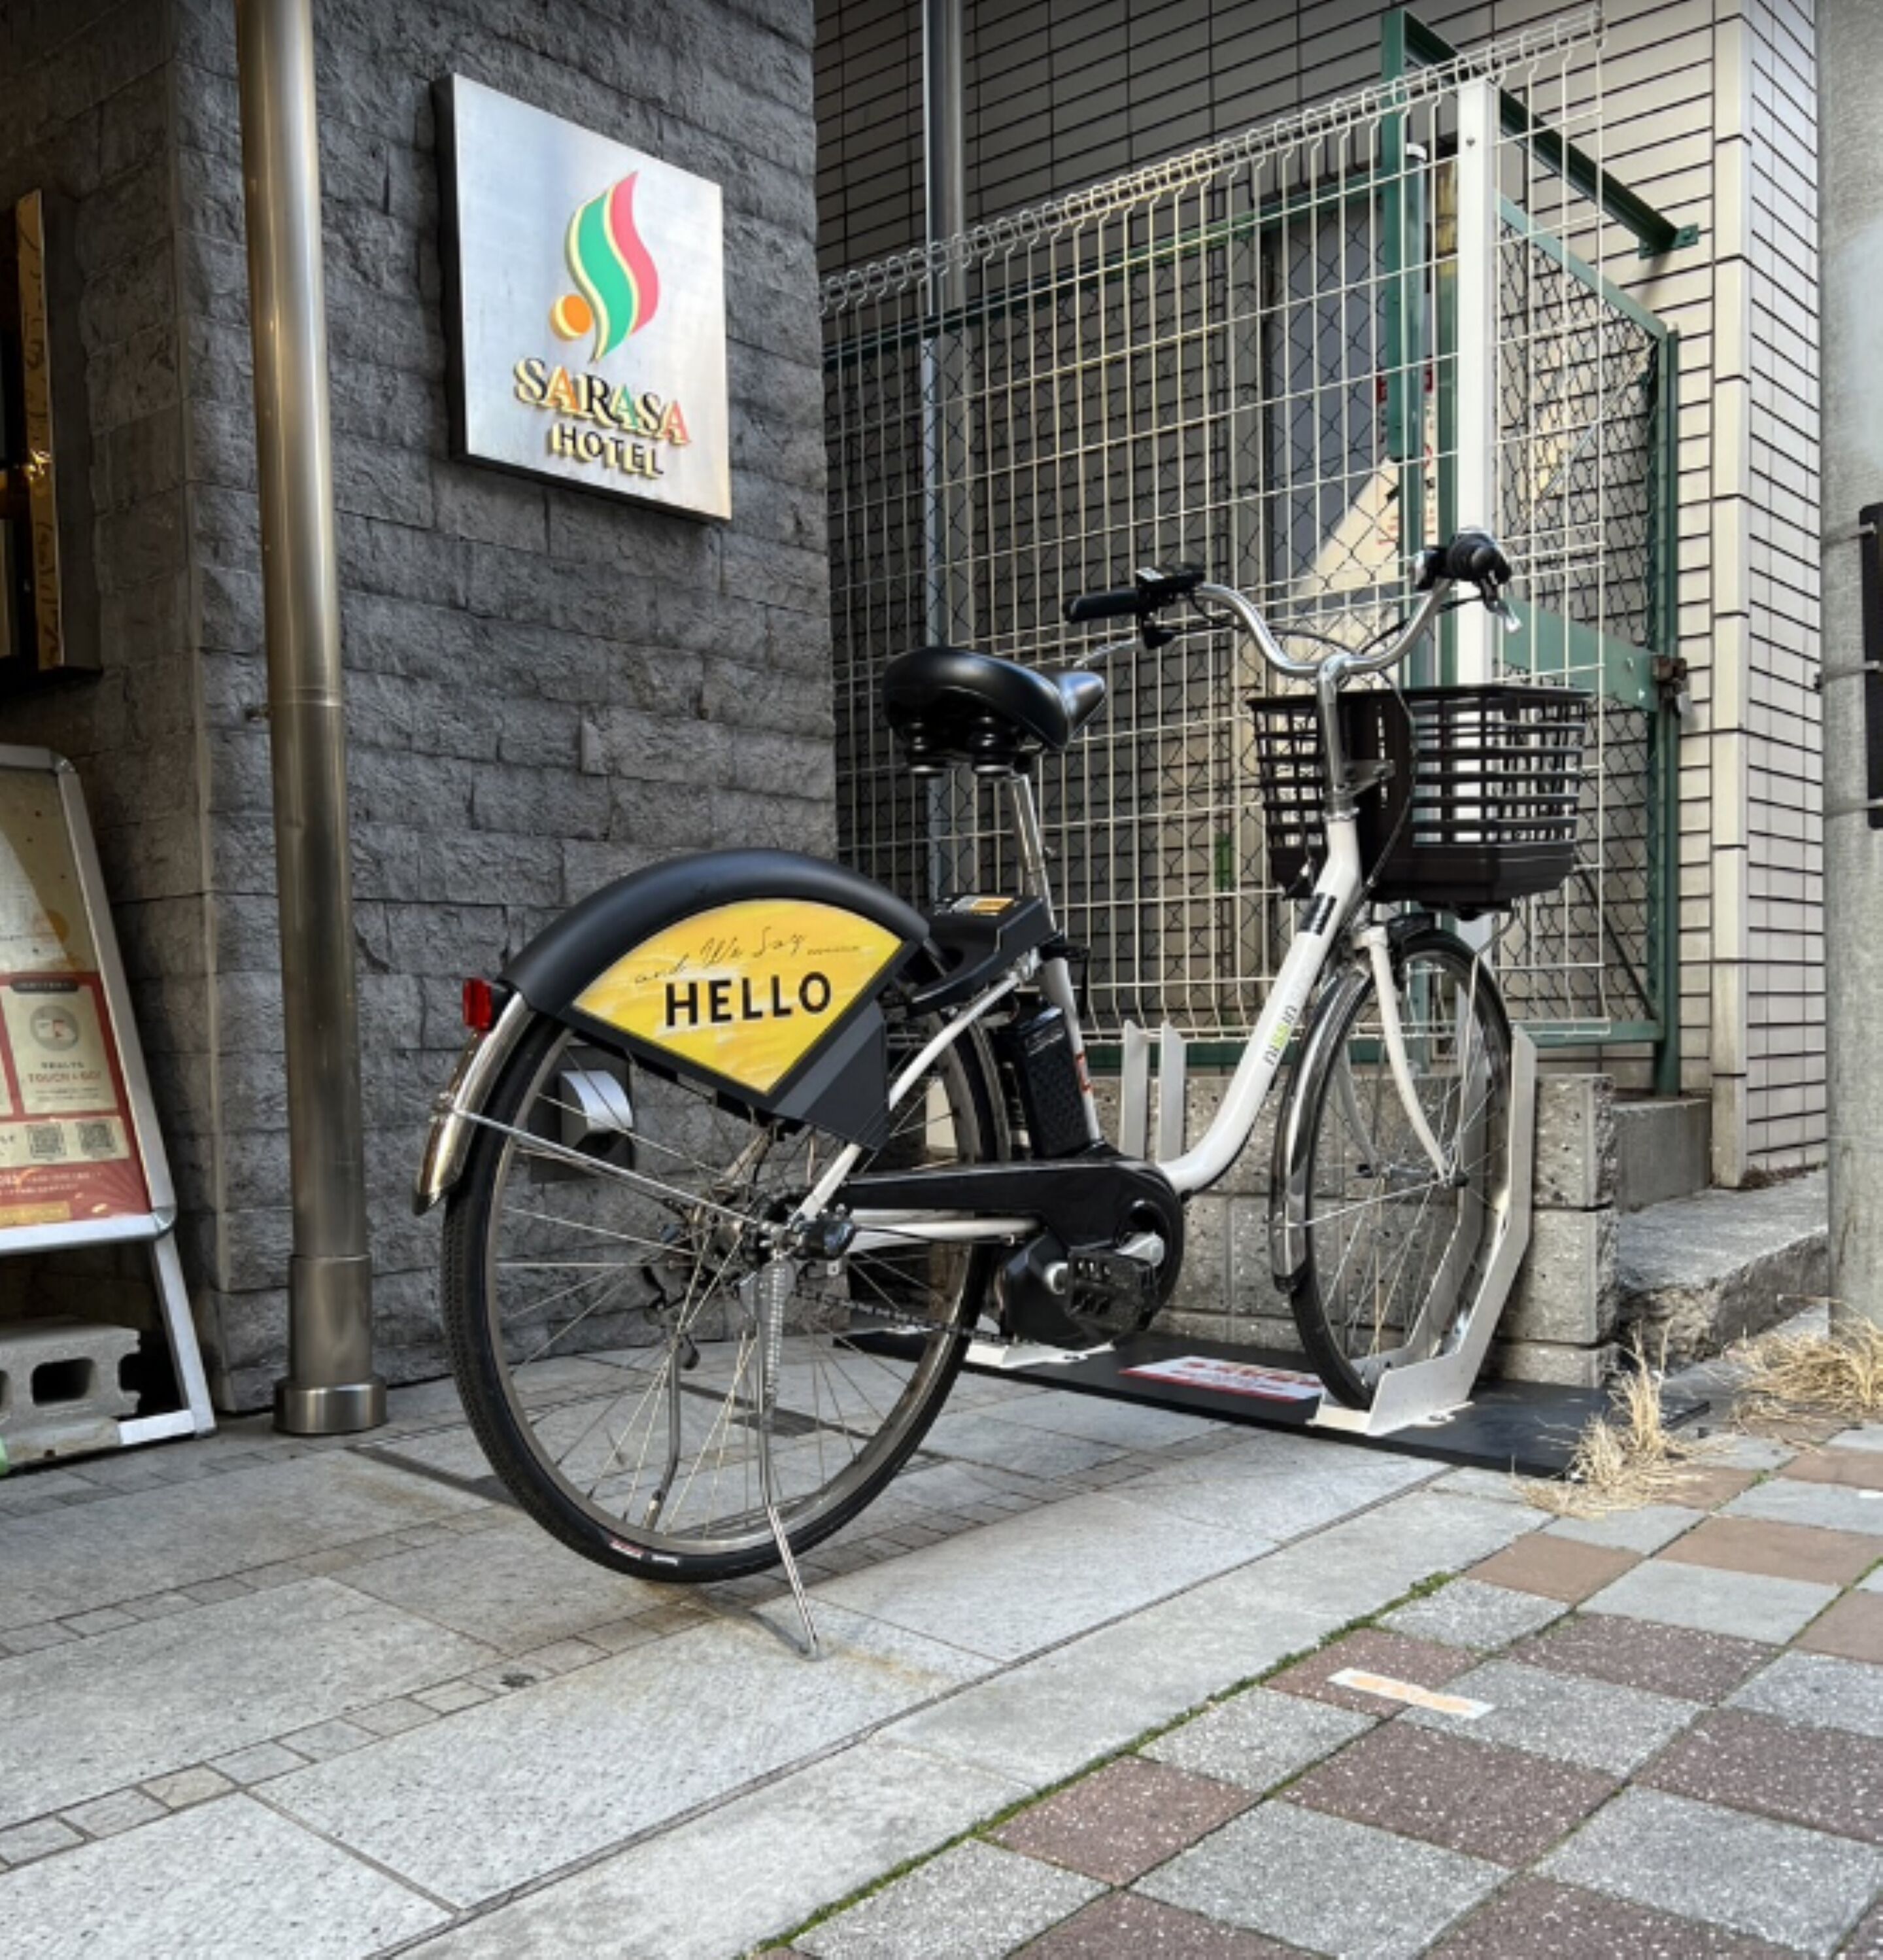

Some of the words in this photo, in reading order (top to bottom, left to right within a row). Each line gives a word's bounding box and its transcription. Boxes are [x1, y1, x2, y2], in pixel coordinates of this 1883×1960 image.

[513, 357, 691, 446] SARASA
[546, 422, 664, 479] HOTEL
[665, 971, 832, 1027] HELLO
